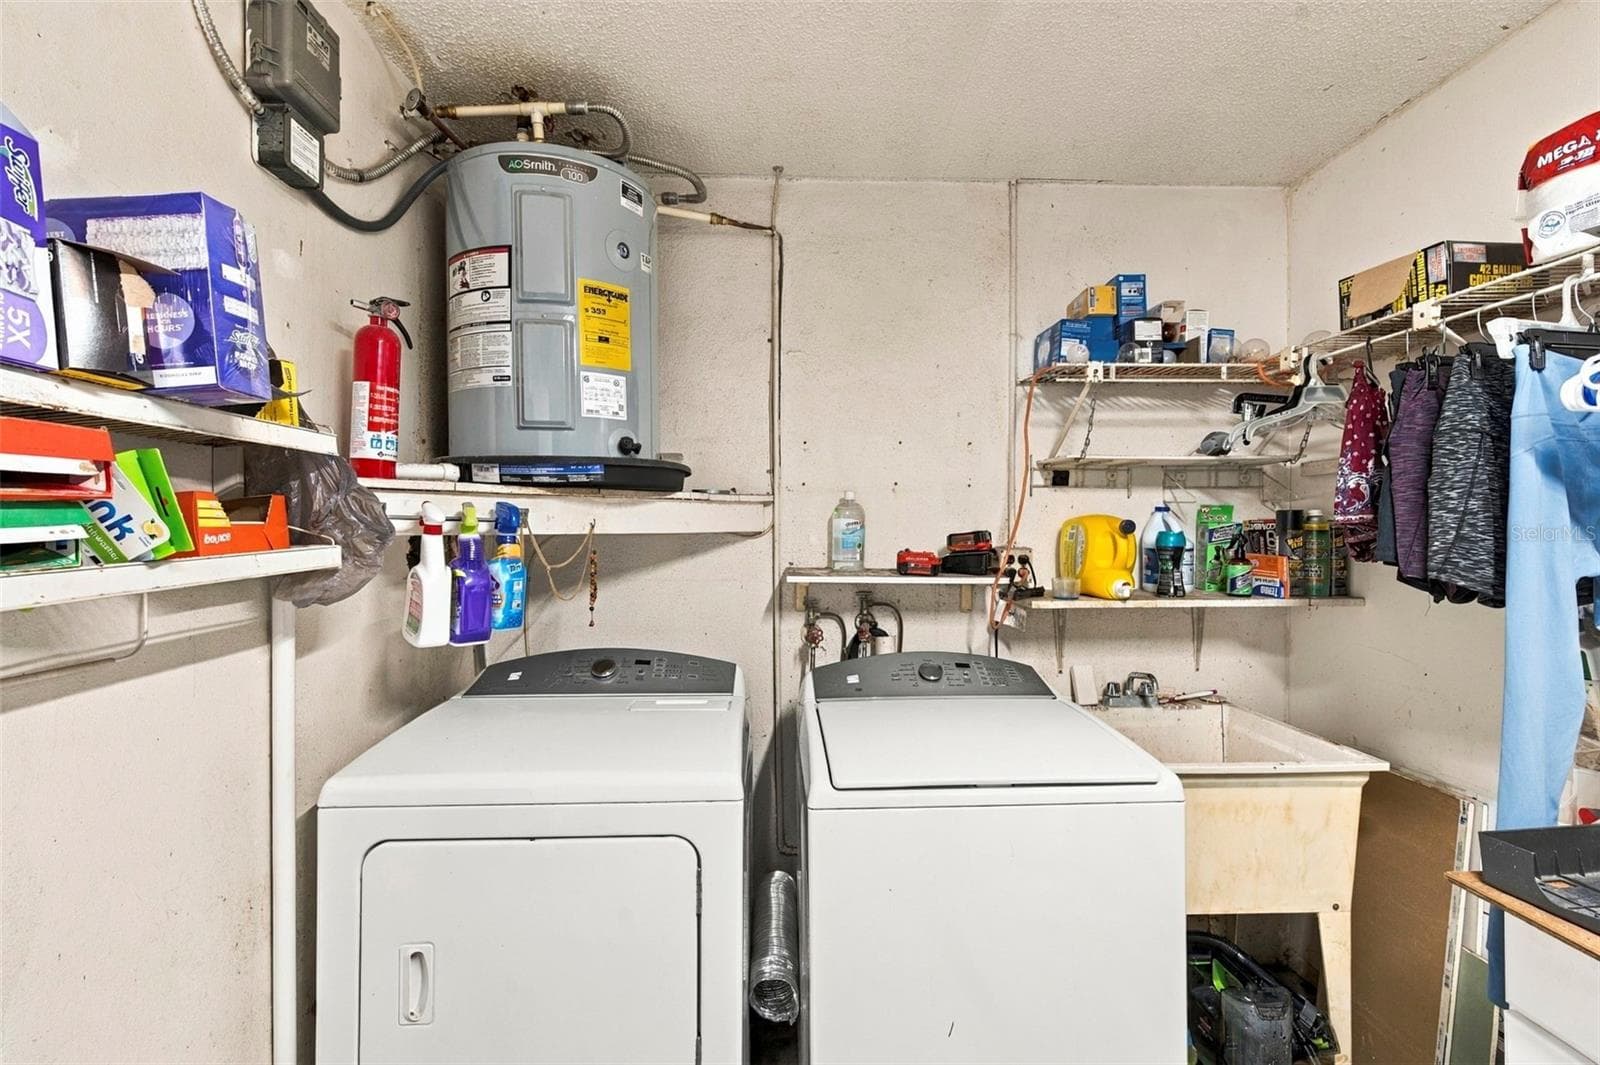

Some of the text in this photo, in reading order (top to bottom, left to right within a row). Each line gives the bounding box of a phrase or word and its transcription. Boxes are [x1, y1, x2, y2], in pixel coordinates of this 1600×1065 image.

[1536, 134, 1592, 169] MEGA
[567, 170, 583, 182] 100
[1480, 264, 1492, 275] 42
[7, 306, 32, 350] 5X
